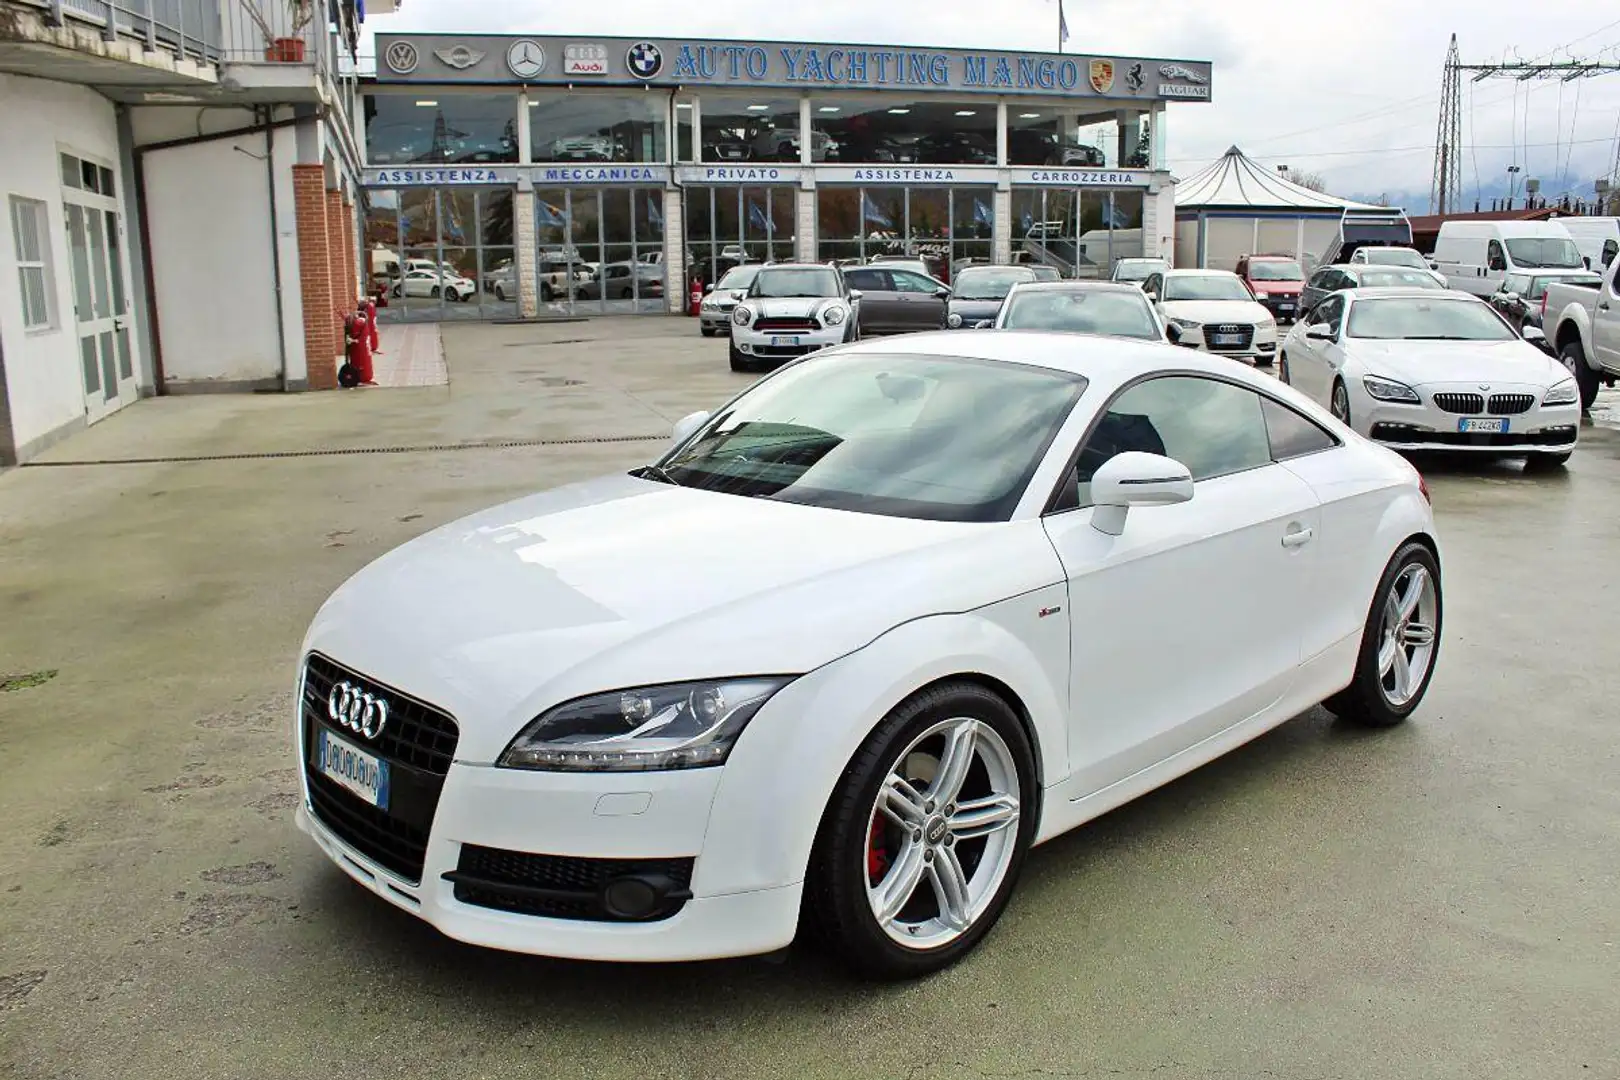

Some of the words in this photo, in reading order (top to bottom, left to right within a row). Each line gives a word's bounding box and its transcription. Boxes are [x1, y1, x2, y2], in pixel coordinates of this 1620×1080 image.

[571, 63, 602, 72] Audi
[672, 44, 767, 79] AUTO
[780, 48, 949, 84] YACHTING
[963, 55, 1079, 89] MANGO
[378, 170, 498, 182] ASSISTENZA
[545, 168, 653, 181] MECCANICA
[706, 168, 779, 180] PRIVATO
[854, 169, 954, 181] ASSISTENZA
[1031, 171, 1133, 183] CARROZZERIA
